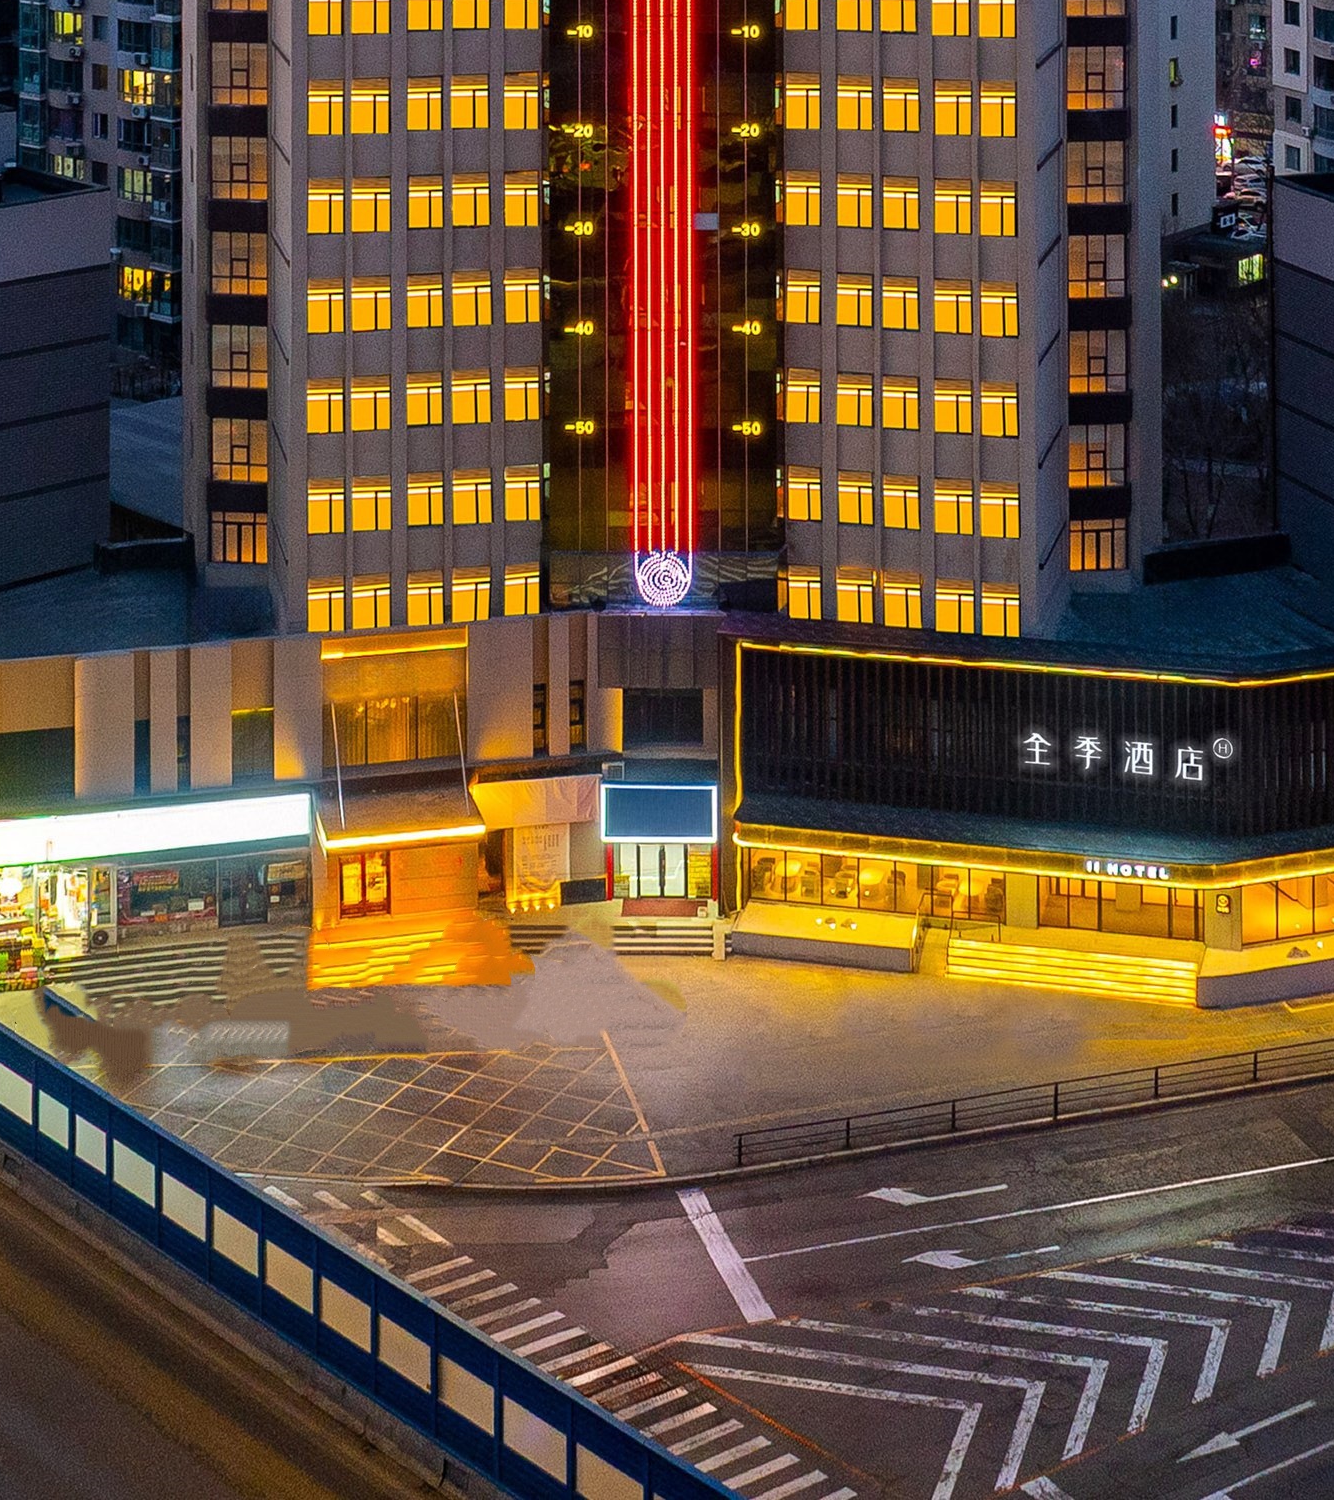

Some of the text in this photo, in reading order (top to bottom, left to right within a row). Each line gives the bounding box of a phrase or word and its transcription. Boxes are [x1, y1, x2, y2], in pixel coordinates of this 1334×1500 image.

[567, 24, 594, 39] -10
[731, 24, 760, 39] -10
[565, 123, 594, 138] -20
[731, 123, 760, 138] -20
[564, 221, 594, 236] -30
[731, 221, 761, 237] -30
[564, 320, 594, 336] -40
[731, 319, 761, 336] -40
[565, 420, 595, 435] -50
[731, 421, 762, 436] -50
[1023, 732, 1204, 781] 全季酒店
[1106, 863, 1170, 880] HOTEL
